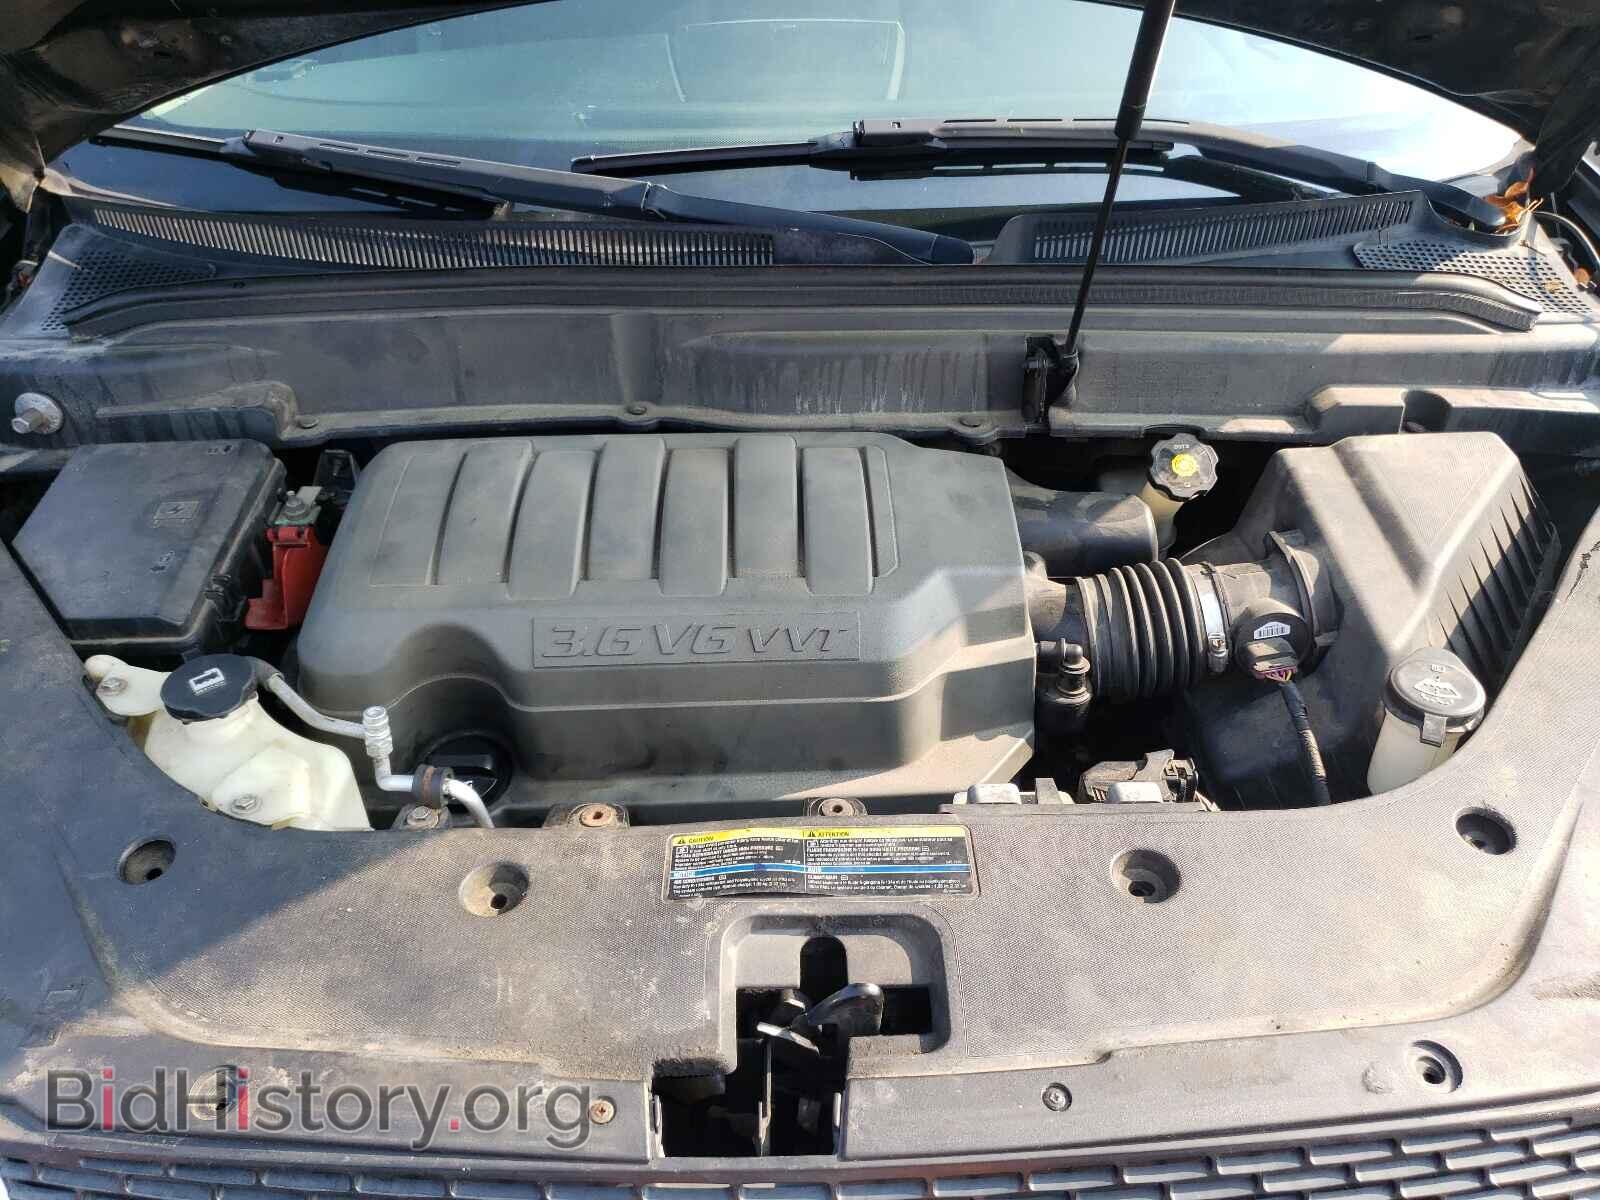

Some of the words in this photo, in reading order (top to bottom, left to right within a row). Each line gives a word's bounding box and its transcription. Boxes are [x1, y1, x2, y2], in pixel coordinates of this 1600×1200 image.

[542, 625, 642, 658] 3.6
[651, 623, 737, 656] V6
[747, 623, 849, 655] VVT
[688, 836, 714, 844] CAUTION
